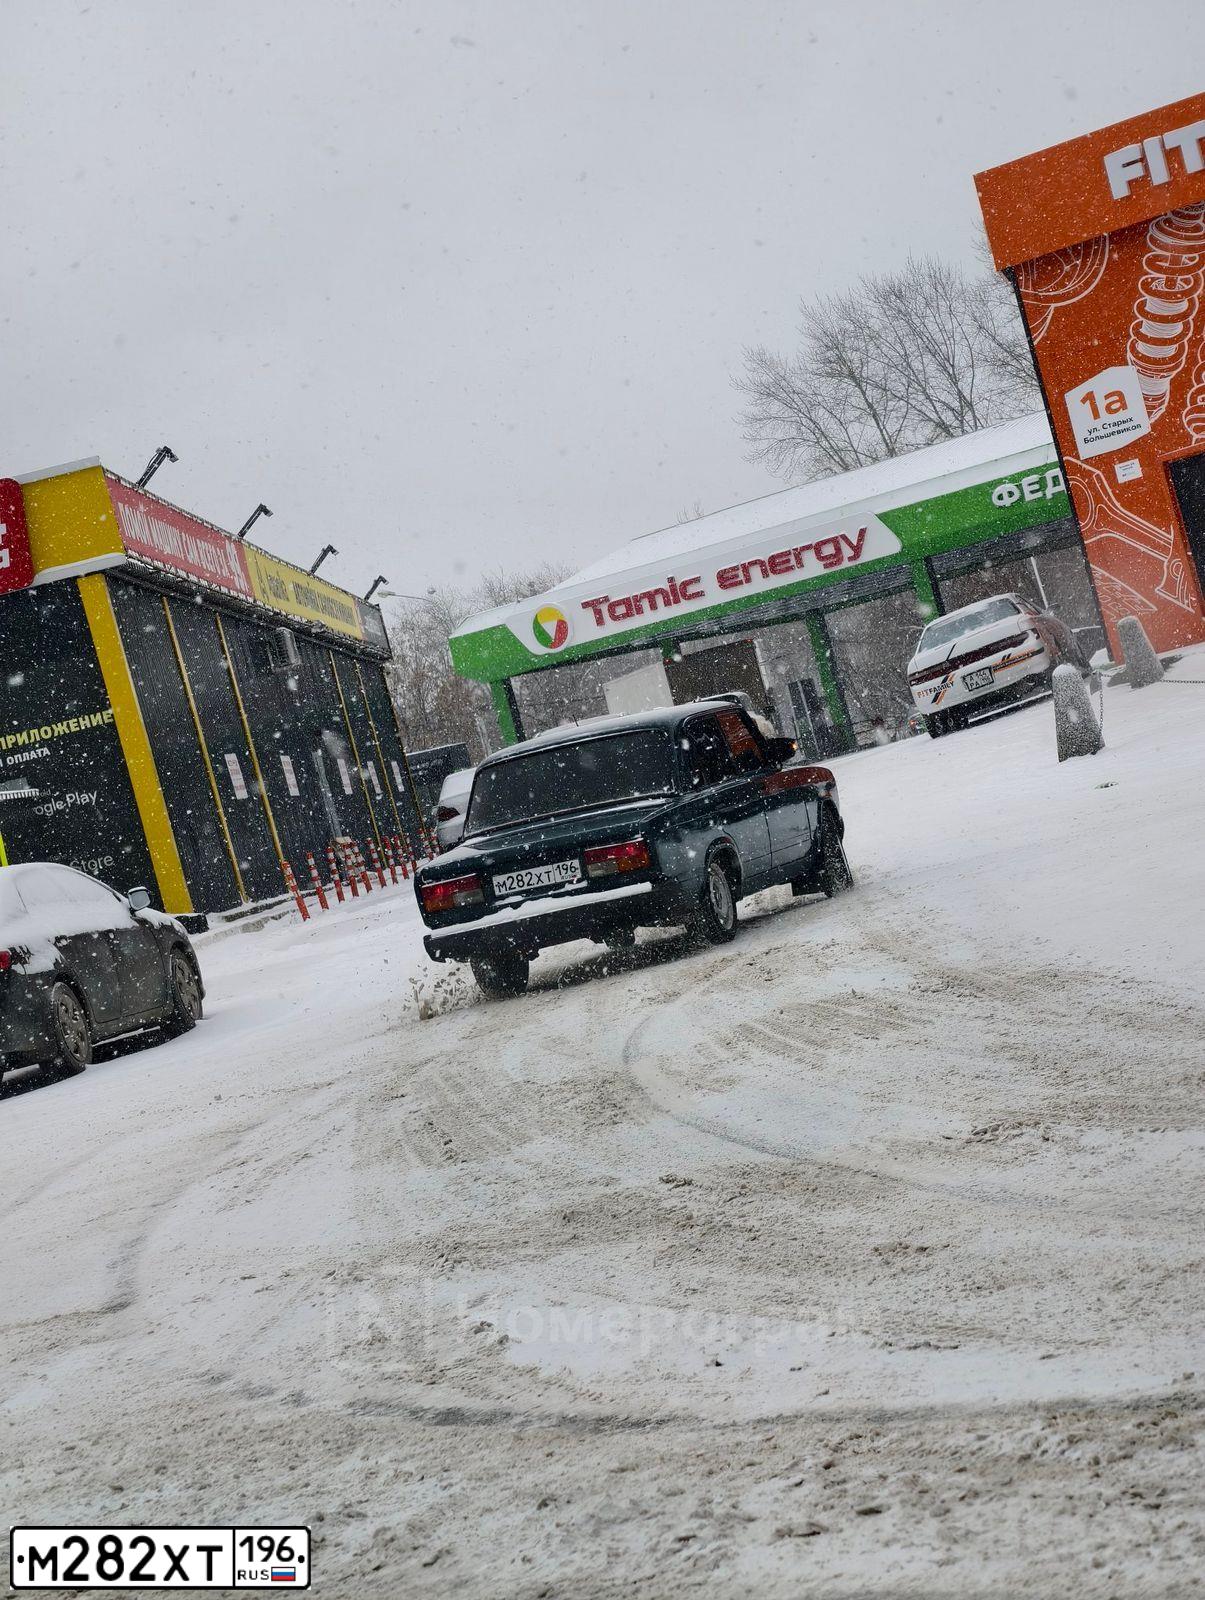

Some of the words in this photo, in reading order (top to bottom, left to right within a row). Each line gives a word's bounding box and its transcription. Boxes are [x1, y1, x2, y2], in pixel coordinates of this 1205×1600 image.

[1103, 119, 1205, 200] FIT
[1102, 416, 1134, 430] Старых
[581, 575, 705, 627] Tamic
[716, 527, 868, 590] energy
[6, 747, 51, 765] ОПЛАТА
[66, 790, 97, 808] Play
[70, 855, 113, 872] Store
[495, 870, 552, 893] М282ХТ
[555, 861, 577, 876] 196
